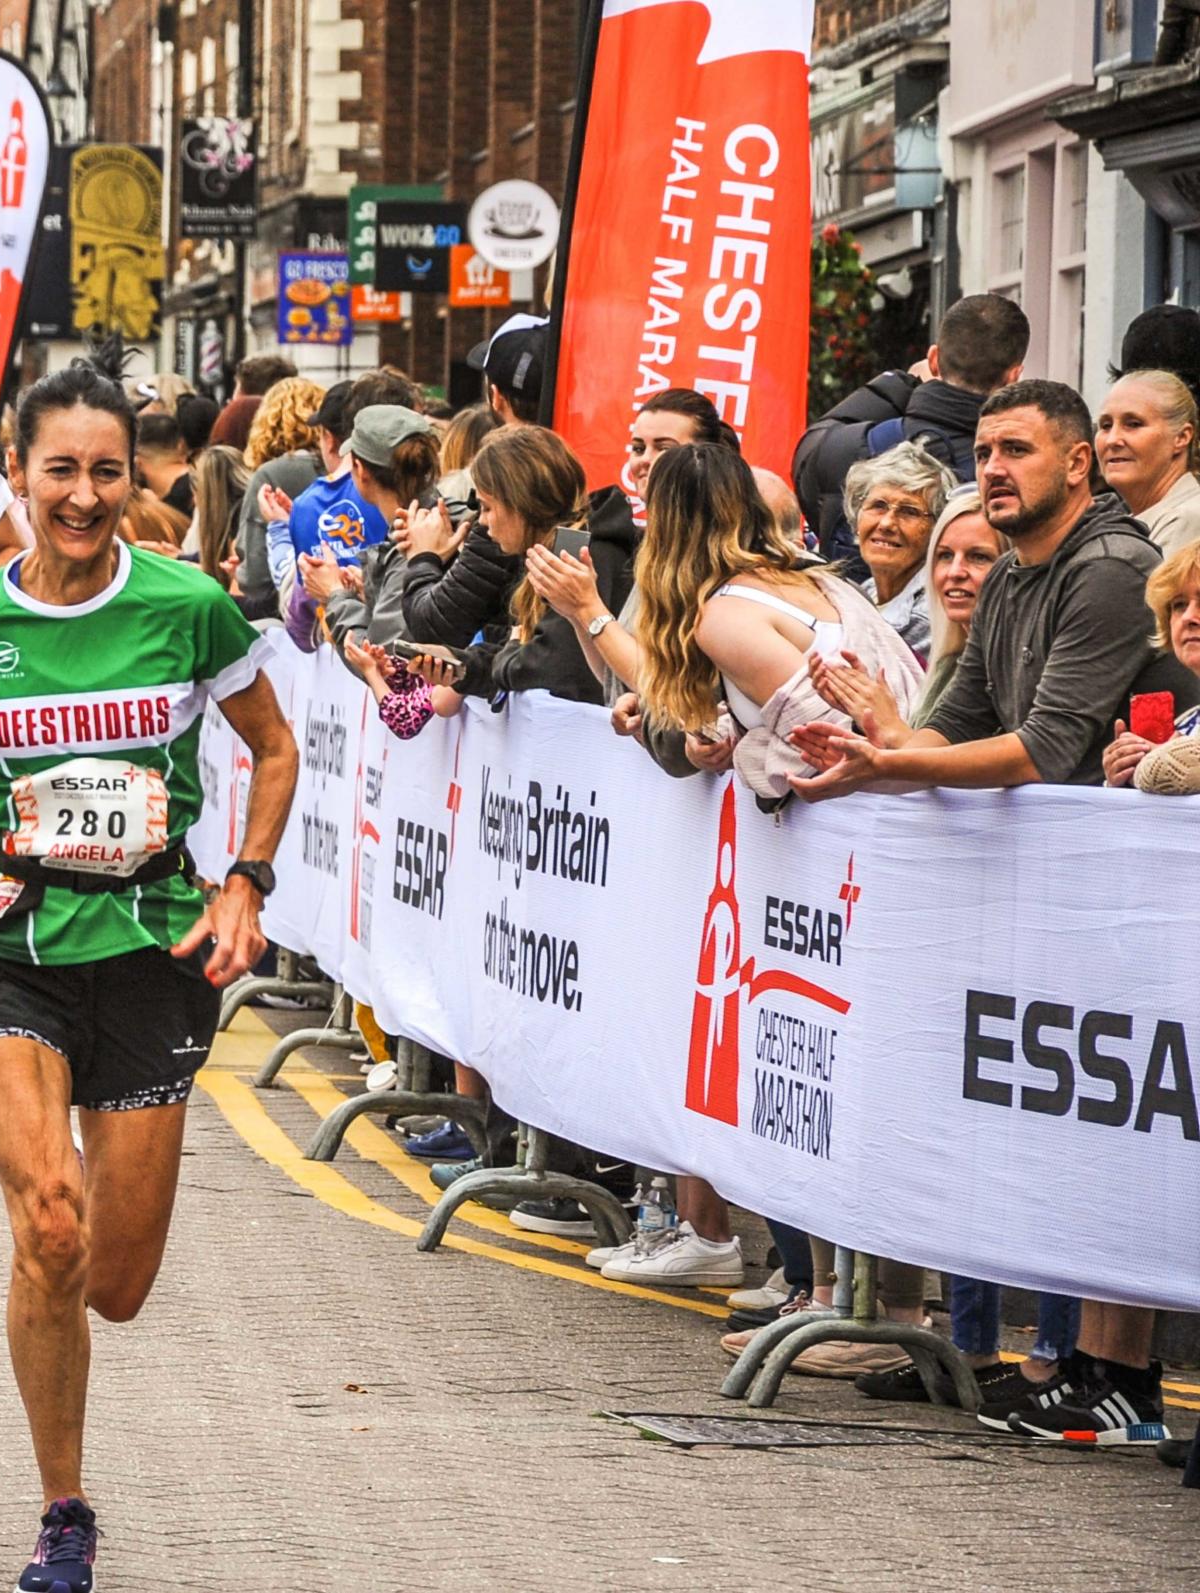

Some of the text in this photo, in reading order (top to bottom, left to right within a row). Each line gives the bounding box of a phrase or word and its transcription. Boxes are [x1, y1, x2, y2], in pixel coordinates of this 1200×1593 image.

[660, 116, 706, 245] HALF
[693, 122, 780, 448] CHESTE
[50, 777, 127, 791] ESSAR
[56, 808, 126, 839] 280
[478, 764, 610, 889] Keeping Britain
[48, 843, 124, 862] ANGELA
[393, 817, 448, 920] ESSAR
[484, 896, 583, 1012] on the move.
[764, 895, 843, 966] ESSAR
[756, 1007, 838, 1082] CHESTER HALF
[751, 1067, 834, 1161] MARATHON
